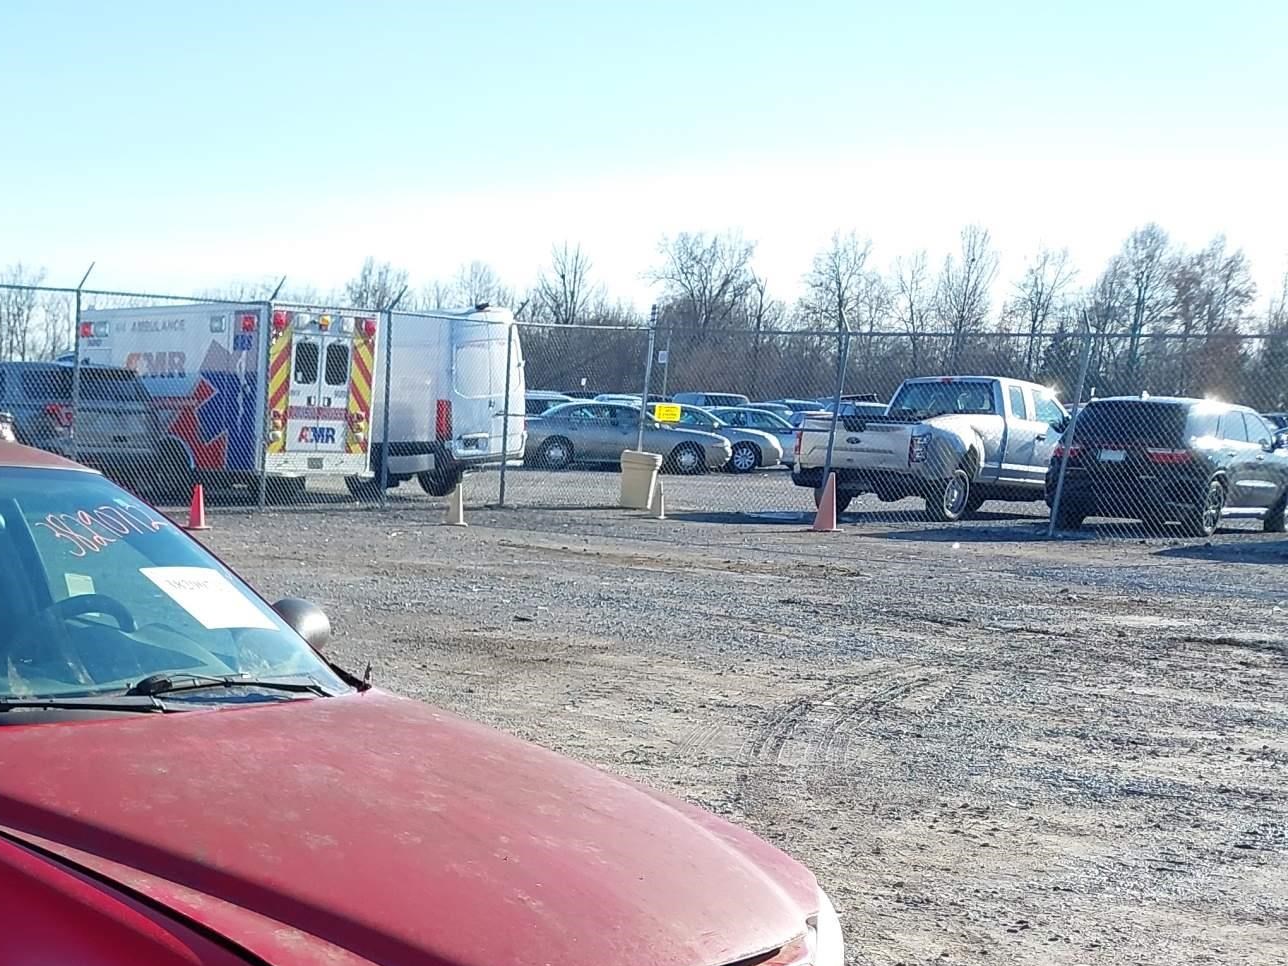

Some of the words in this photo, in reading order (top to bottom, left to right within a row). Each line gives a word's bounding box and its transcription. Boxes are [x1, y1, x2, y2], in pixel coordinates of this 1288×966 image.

[131, 319, 186, 333] AMBULANCE
[298, 426, 336, 444] AMR
[35, 505, 168, 557] 38290712
